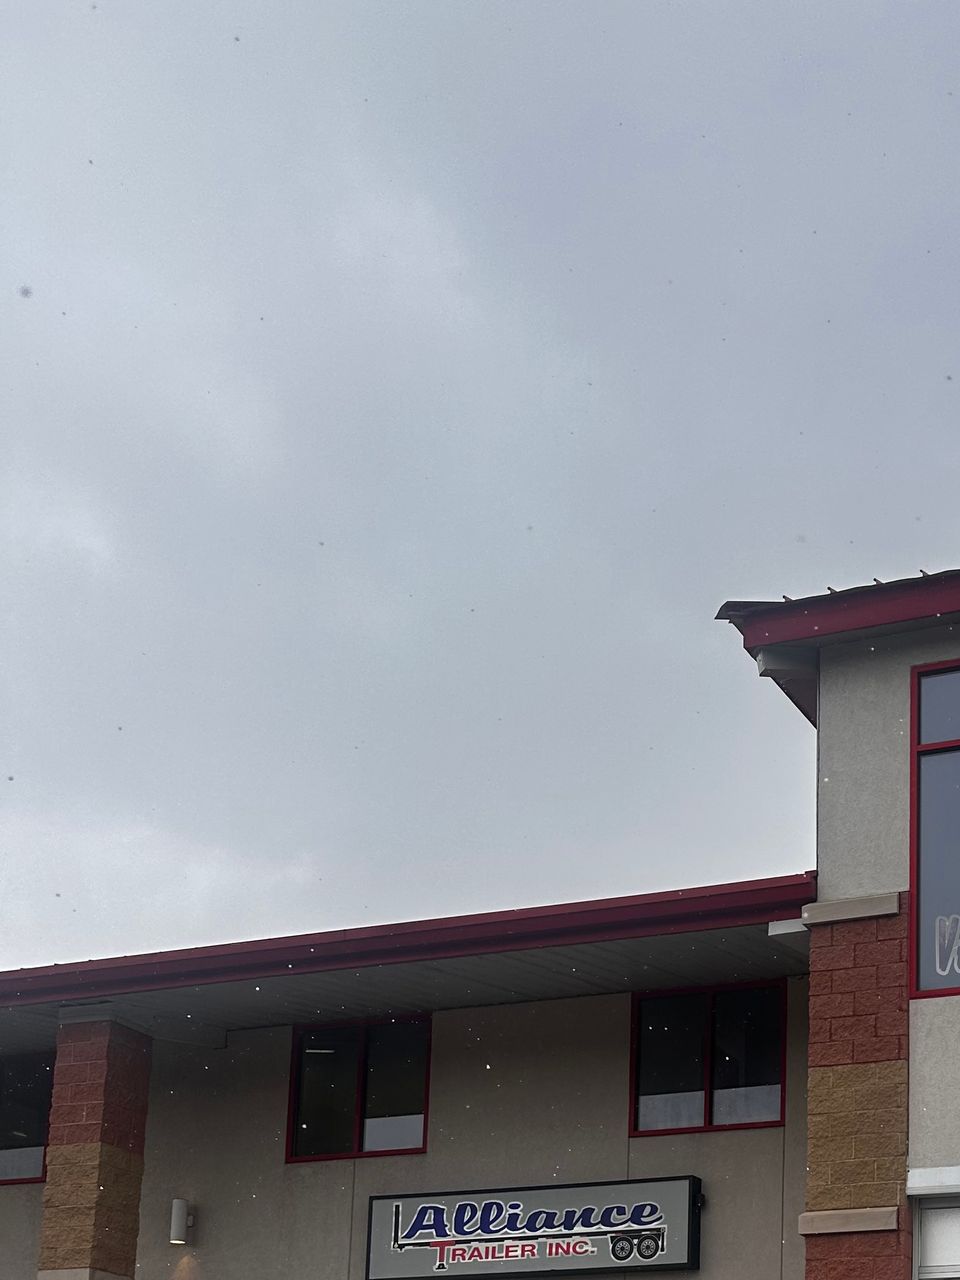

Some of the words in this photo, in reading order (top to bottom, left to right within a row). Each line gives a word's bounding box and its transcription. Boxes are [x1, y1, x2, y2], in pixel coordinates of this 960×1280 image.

[402, 1201, 664, 1239] Alliance
[429, 1240, 536, 1265] TRAILER
[548, 1240, 597, 1257] INC.
